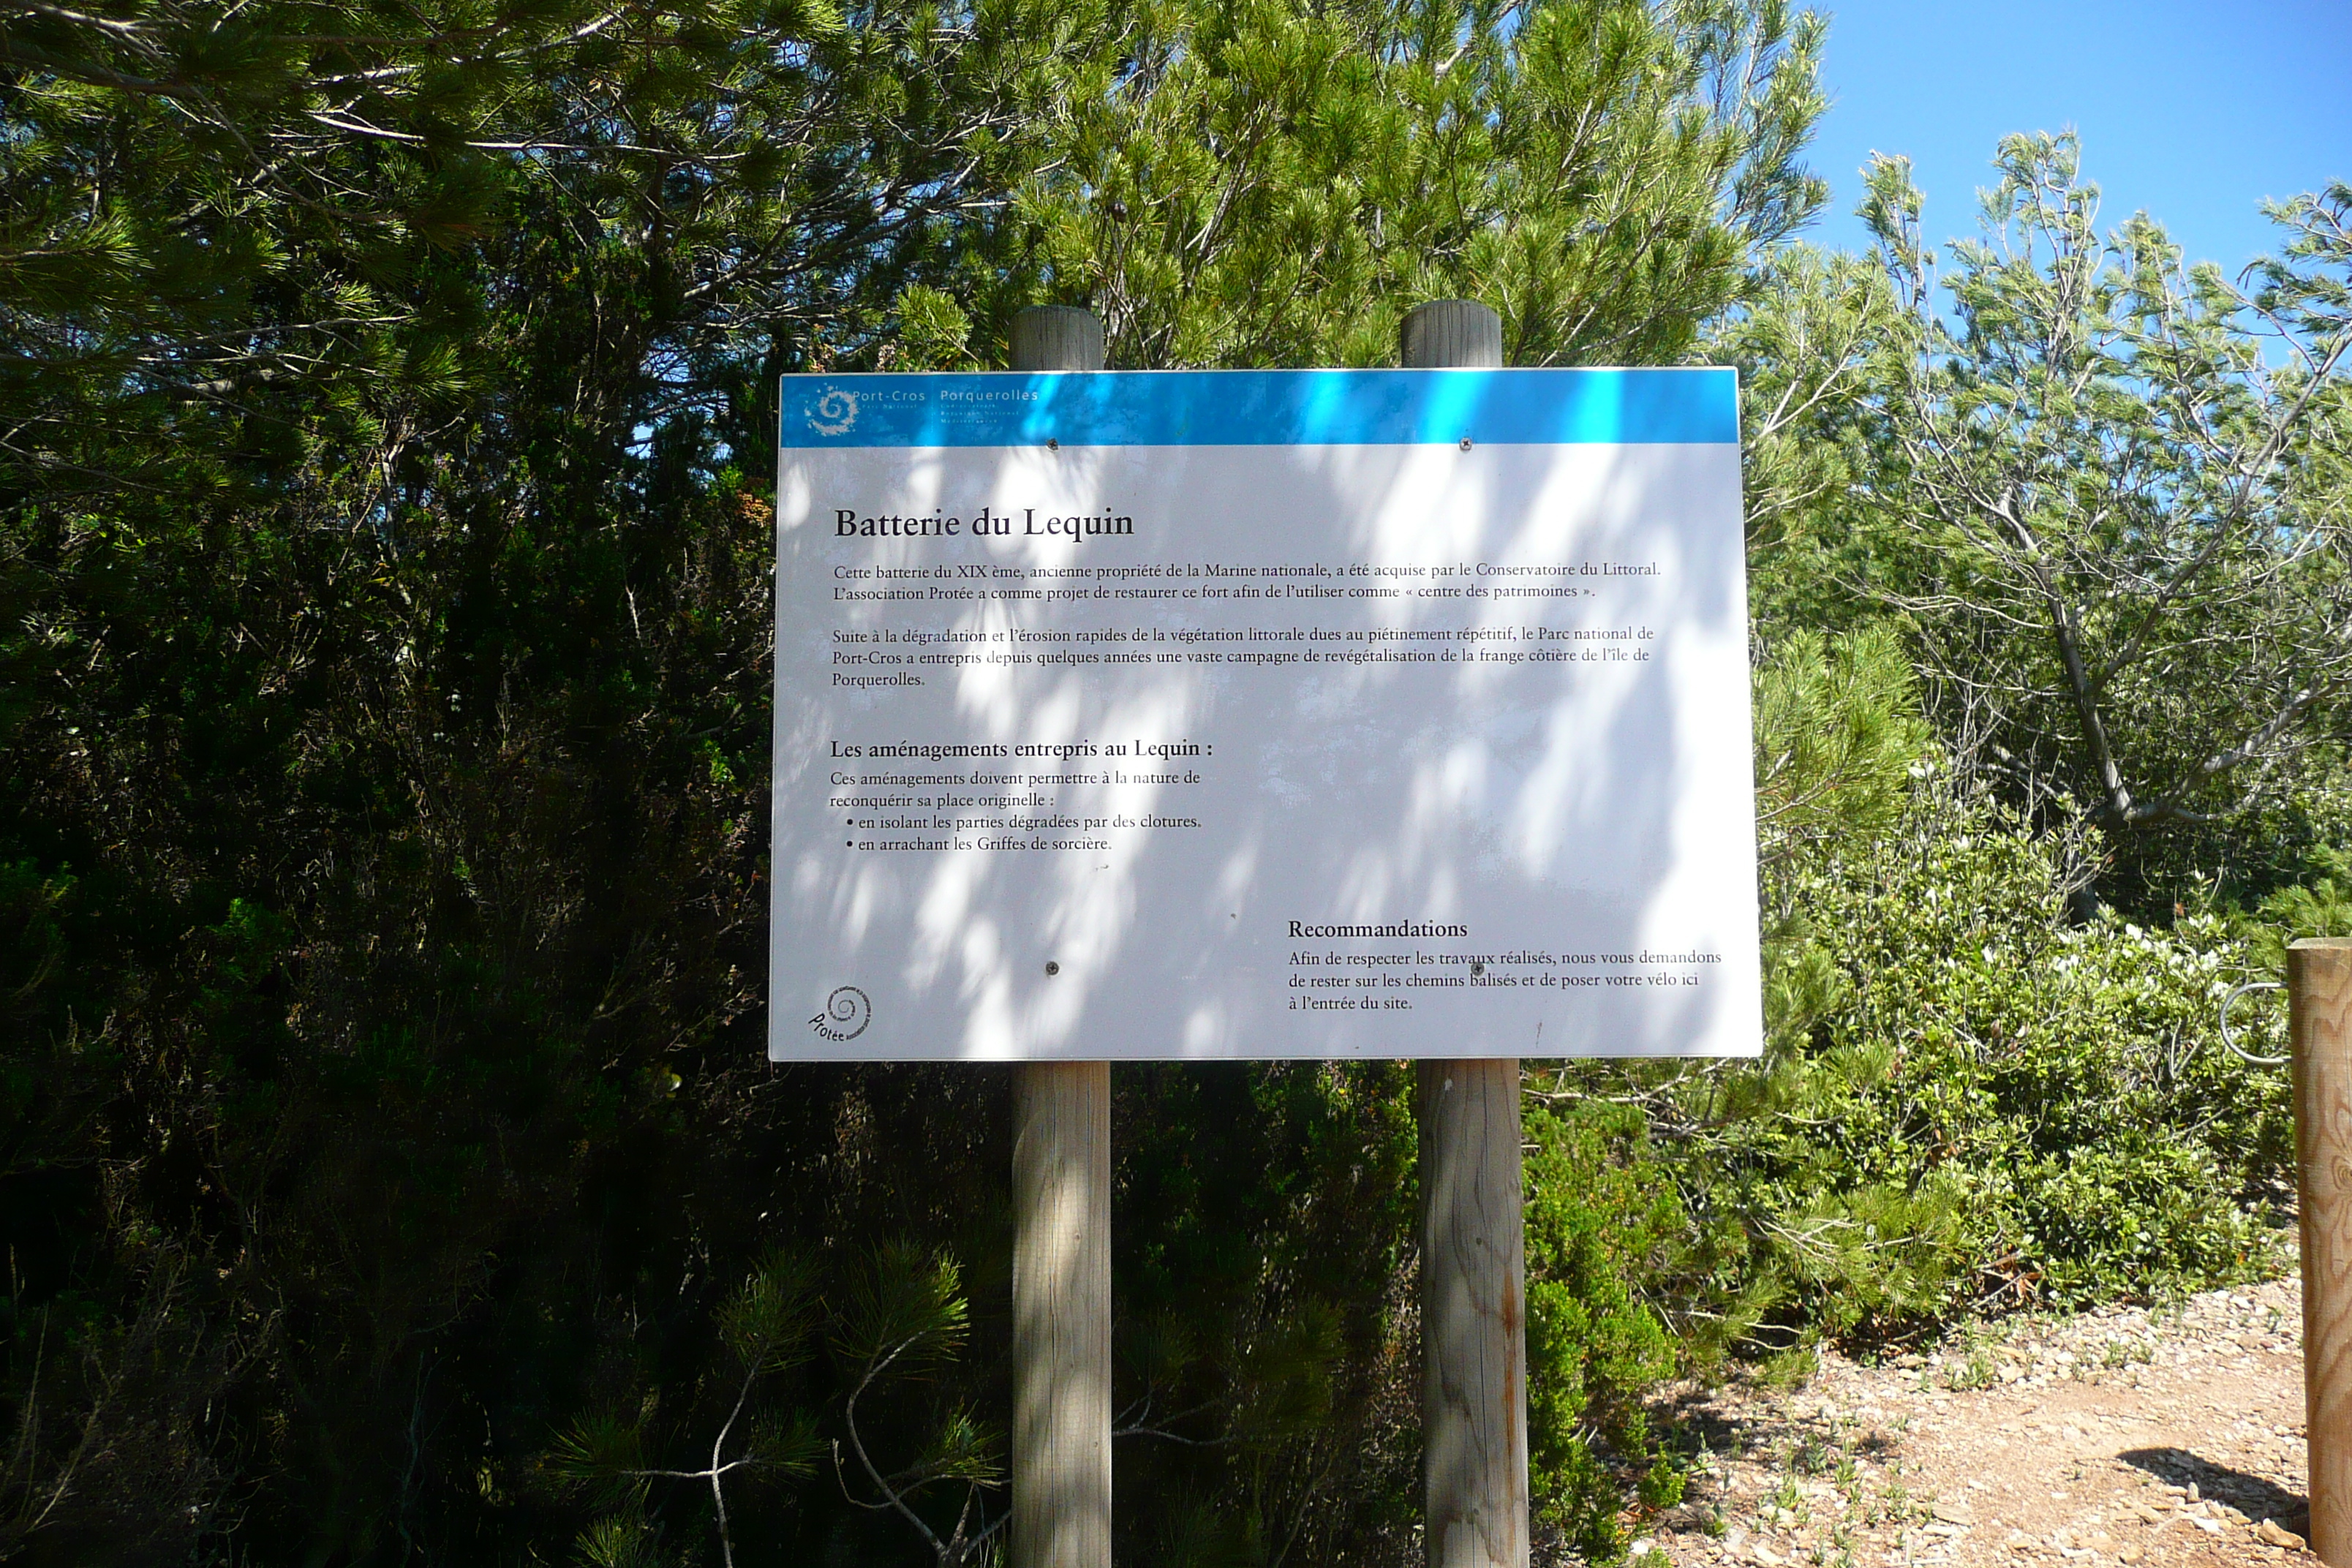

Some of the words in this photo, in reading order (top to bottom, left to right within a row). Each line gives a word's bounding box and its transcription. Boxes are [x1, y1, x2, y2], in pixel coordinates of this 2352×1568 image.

[853, 391, 925, 402] Port-Cros
[941, 389, 1038, 403] Porquerolles
[834, 508, 960, 537] Batterie
[971, 506, 1011, 536] du
[1023, 507, 1135, 543] Lequin
[834, 565, 872, 579] Cette
[876, 565, 930, 579] batterie
[933, 564, 952, 578] du
[957, 565, 988, 578] XIX
[992, 565, 1025, 581] ème,
[1029, 568, 1092, 578] ancienne
[1096, 564, 1161, 581] propriété
[1166, 563, 1183, 577] de
[1187, 563, 1200, 577] la
[1204, 563, 1257, 578] Marine
[1261, 562, 1332, 579] nationale,
[1336, 567, 1344, 576] a
[1349, 562, 1370, 576] été
[1373, 563, 1426, 579] acquise
[1431, 567, 1455, 579] par
[1459, 562, 1471, 576] le
[1476, 562, 1576, 576] Conservatoire
[1580, 562, 1598, 576] du
[1603, 562, 1661, 576] Littoral.
[929, 586, 974, 600] Protée
[978, 590, 987, 600] a
[990, 589, 1042, 600] comme
[1047, 589, 1090, 603] projet
[1093, 584, 1110, 599] de
[1115, 588, 1178, 599] restaurer
[1182, 589, 1197, 598] ce
[1202, 584, 1229, 598] fort
[1232, 584, 1260, 598] afin
[1264, 584, 1282, 598] de
[1348, 588, 1400, 598] comme
[1417, 587, 1461, 598] centre
[1466, 583, 1489, 598] des
[1493, 587, 1578, 600] patrimoines
[832, 630, 868, 644] Suite
[872, 630, 881, 643] à
[885, 628, 898, 643] la
[902, 627, 987, 647] dégradation
[992, 632, 1005, 642] et
[1076, 627, 1127, 646] rapides
[1131, 627, 1148, 641] de
[1153, 627, 1166, 641] la
[1170, 627, 1244, 645] végétation
[1248, 627, 1305, 641] littorale
[1309, 627, 1341, 641] dues
[1346, 631, 1364, 641] au
[1368, 627, 1452, 644] piétinement
[1456, 626, 1517, 644] répétitif,
[1522, 626, 1534, 640] le
[1538, 627, 1569, 640] Parc
[1574, 625, 1632, 640] national
[1637, 625, 1654, 640] de
[832, 650, 902, 665] Port-Cros
[906, 655, 915, 665] a
[919, 653, 981, 668] entrepris
[987, 650, 1032, 667] depuis
[1036, 649, 1099, 667] quelques
[1104, 649, 1152, 663] années
[1156, 653, 1183, 663] une
[1186, 652, 1223, 663] vaste
[1226, 652, 1299, 666] campagne
[1303, 648, 1320, 663] de
[1324, 648, 1436, 666] revégétalisation
[1440, 648, 1458, 662] de
[1462, 647, 1474, 662] la
[1480, 647, 1524, 665] frange
[1529, 648, 1577, 663] côtière
[1581, 647, 1598, 661] de
[1632, 647, 1649, 661] de
[832, 672, 925, 690] Porquerolles.
[830, 740, 862, 758] Les
[868, 739, 1008, 762] aménagements
[1014, 739, 1098, 761] entrepris
[1104, 745, 1127, 757] au
[1135, 739, 1200, 761] Lequin
[830, 772, 856, 785] Ces
[860, 770, 965, 788] aménagements
[970, 770, 1024, 785] doivent
[1028, 774, 1098, 788] permettre
[1101, 770, 1110, 784] à
[1115, 770, 1127, 784] la
[1134, 774, 1179, 784] nature
[1183, 769, 1201, 784] de
[829, 793, 913, 810] reconquérir
[917, 797, 932, 807] sa
[936, 792, 974, 810] place
[978, 792, 1045, 810] originelle
[859, 819, 875, 829] en
[880, 814, 929, 829] isolant
[932, 814, 951, 829] les
[956, 818, 1004, 832] parties
[1009, 813, 1079, 832] dégradées
[1083, 818, 1108, 832] par
[1112, 813, 1136, 828] des
[1140, 813, 1202, 828] clotures.
[858, 841, 875, 851] en
[879, 836, 949, 851] arrachant
[954, 836, 972, 851] les
[977, 835, 1026, 851] Griffes
[1030, 835, 1048, 850] de
[1052, 836, 1112, 850] sorcière.
[1288, 918, 1468, 938] Recommandations
[1289, 950, 1320, 965] Afin
[1324, 951, 1342, 965] de
[1346, 954, 1411, 969] respecter
[1416, 950, 1435, 965] les
[1439, 954, 1496, 965] travaux
[1500, 949, 1557, 967] réalisés,
[1561, 954, 1597, 964] nous
[1600, 954, 1635, 964] vous
[1639, 949, 1722, 963] demandons
[1289, 973, 1305, 988] de
[1310, 976, 1351, 988] rester
[1355, 977, 1379, 987] sur
[1382, 972, 1401, 987] les
[1406, 972, 1465, 987] chemins
[1469, 972, 1518, 987] balisés
[1521, 976, 1535, 987] et
[1539, 972, 1557, 987] de
[1561, 976, 1601, 990] poser
[1605, 976, 1643, 986] votre
[1647, 971, 1677, 986] vélo
[1682, 972, 1698, 986] ici
[1289, 996, 1297, 1010] à
[1360, 995, 1379, 1010] du
[1383, 996, 1412, 1009] site.
